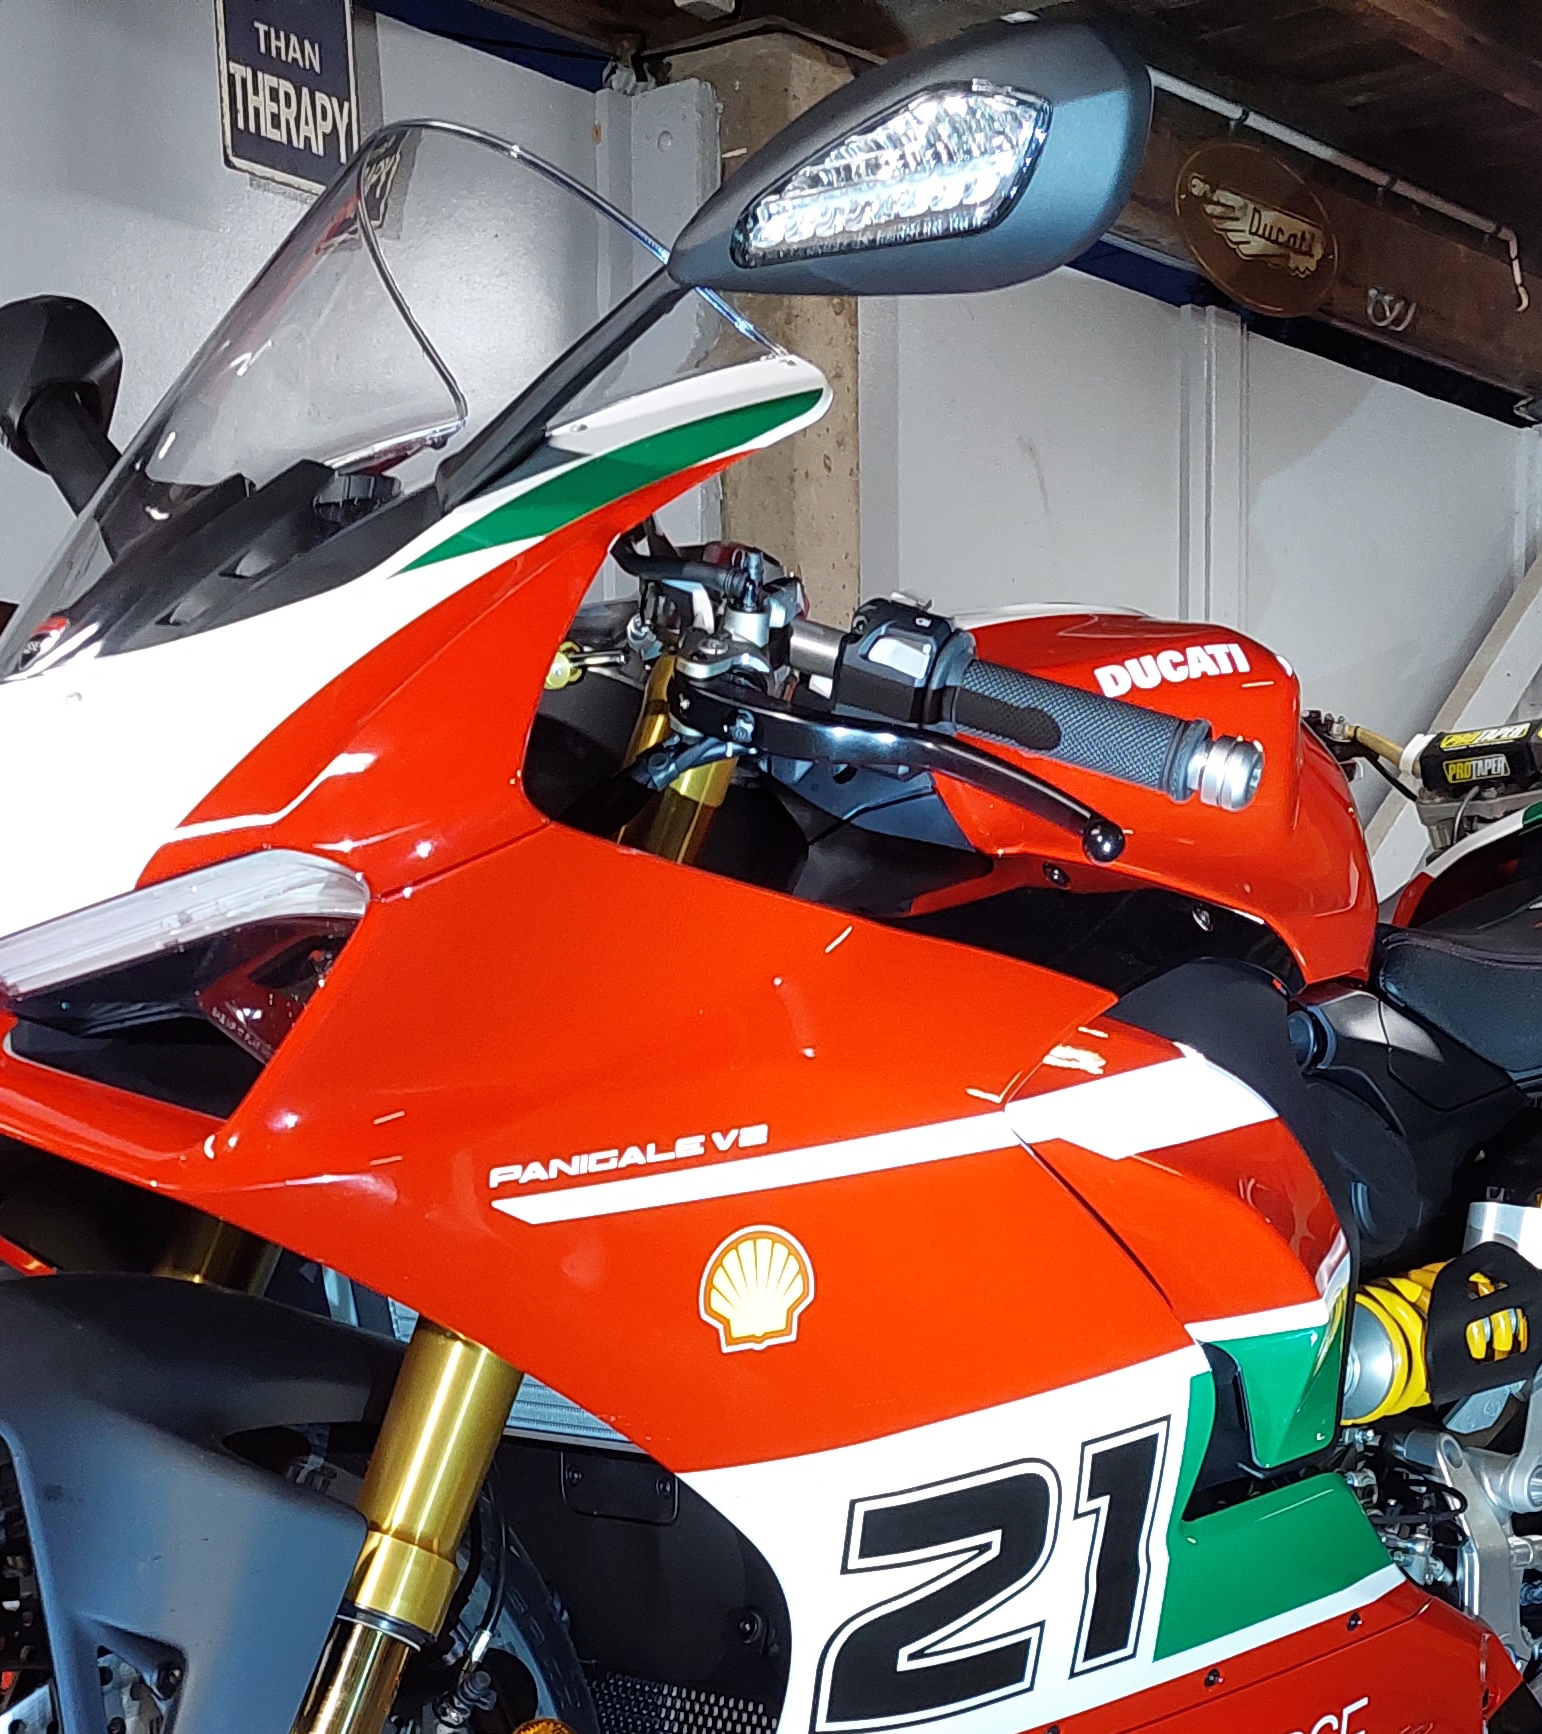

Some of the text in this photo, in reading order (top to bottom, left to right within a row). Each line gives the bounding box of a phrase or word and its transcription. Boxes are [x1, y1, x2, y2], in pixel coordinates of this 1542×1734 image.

[253, 20, 321, 75] THAN
[228, 60, 349, 165] THERAPY
[1249, 206, 1317, 257] Ducati
[1094, 643, 1250, 698] DUCATI
[488, 1123, 769, 1189] PANIGALE V2
